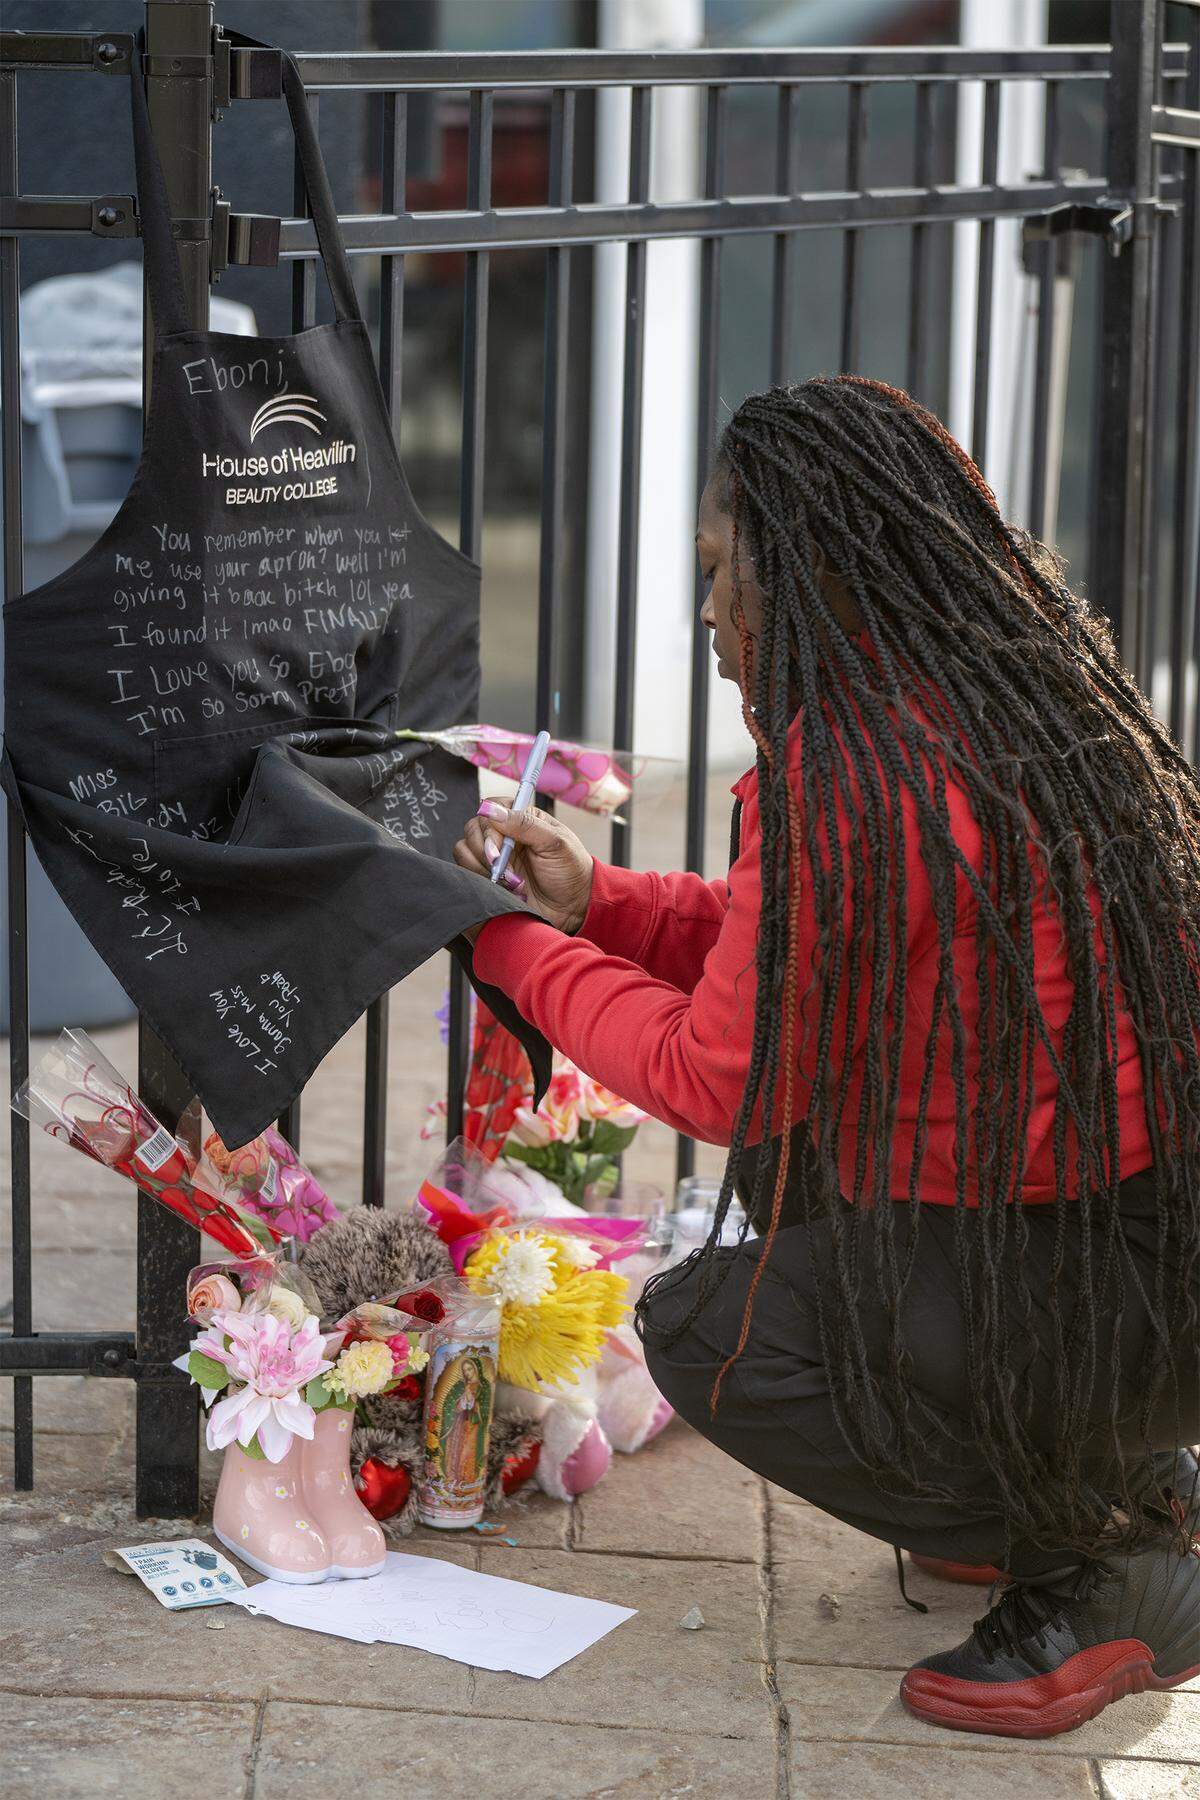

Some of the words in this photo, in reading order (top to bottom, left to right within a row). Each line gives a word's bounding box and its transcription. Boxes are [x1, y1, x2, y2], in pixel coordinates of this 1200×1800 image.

[202, 452, 269, 477] House
[270, 447, 290, 475] of
[290, 440, 357, 472] Heavilin
[226, 486, 282, 504] BEAUTY
[283, 476, 338, 501] COLLEGE
[152, 523, 191, 552] You
[203, 525, 296, 553] remember
[305, 524, 344, 546] when
[169, 562, 202, 581] use
[214, 560, 251, 586] your
[113, 582, 186, 613] giving
[202, 583, 220, 605] it
[108, 625, 138, 647] I
[142, 615, 208, 647] found
[214, 615, 232, 641] it
[107, 669, 141, 704] I
[149, 660, 211, 696] Love
[126, 704, 186, 736] I'm
[254, 1058, 278, 1075] I
